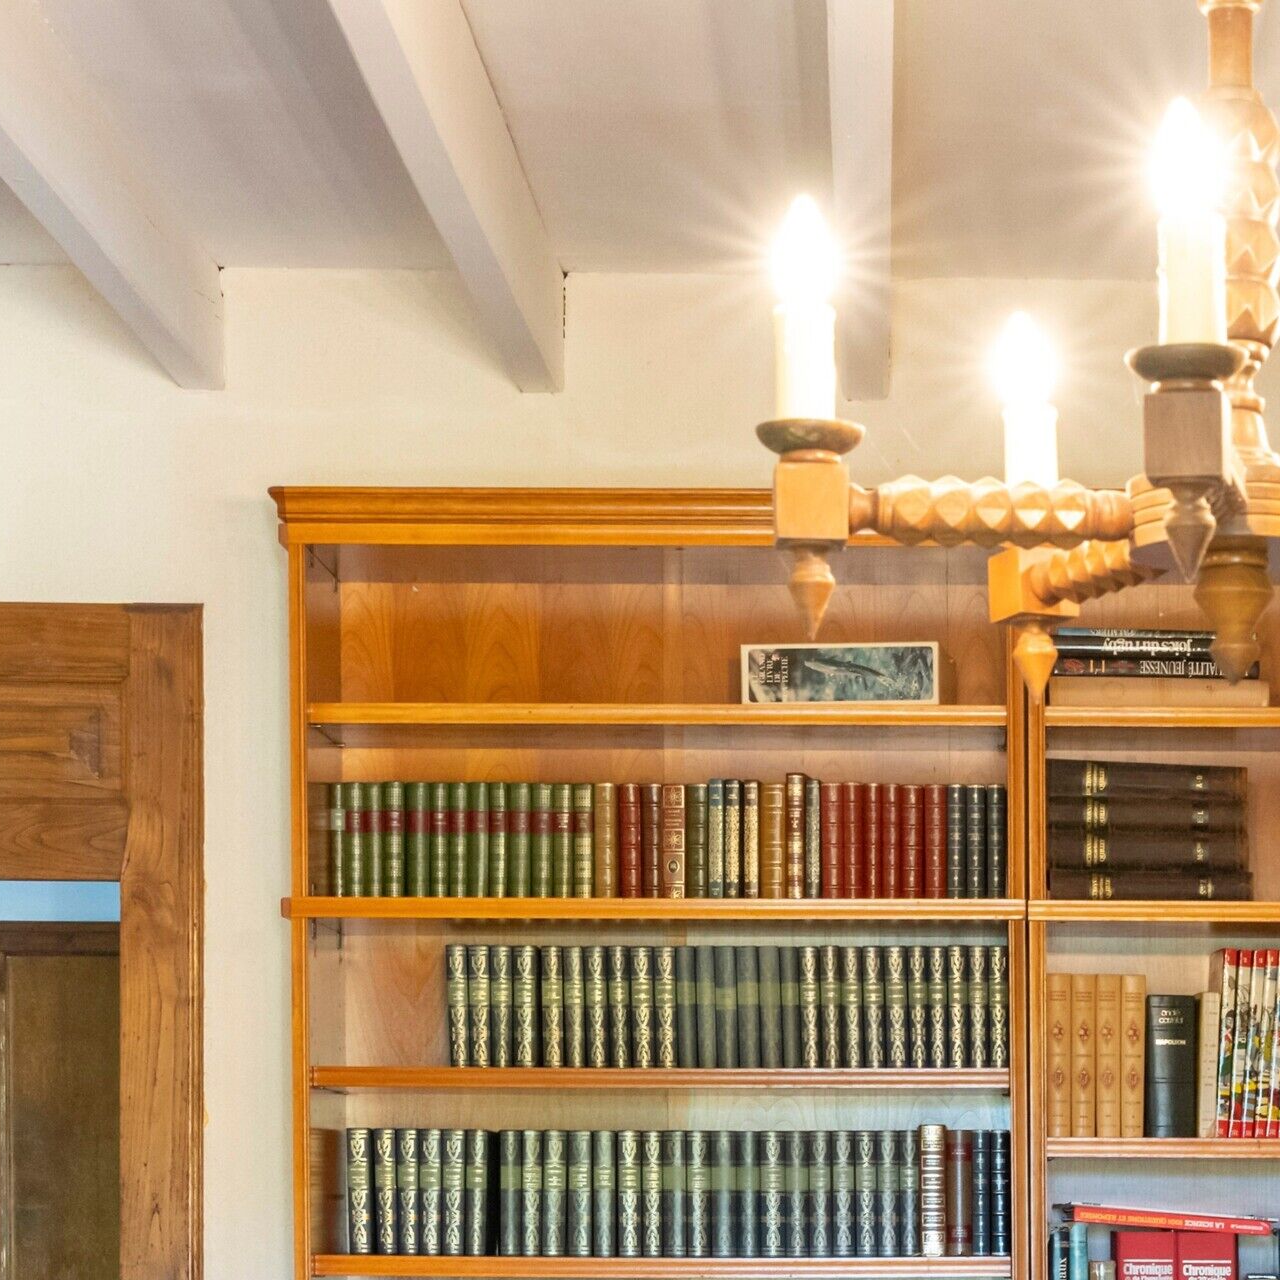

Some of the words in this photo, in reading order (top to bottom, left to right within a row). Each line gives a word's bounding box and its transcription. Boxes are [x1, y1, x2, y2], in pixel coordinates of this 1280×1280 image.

[1102, 638, 1140, 656] rugby
[1140, 640, 1159, 656] du
[1160, 639, 1193, 656] joies
[1139, 660, 1187, 676] JEUNESSE
[1188, 662, 1224, 678] UALITÉ
[1123, 1263, 1173, 1278] Chronique
[1183, 1265, 1232, 1279] Chronique
